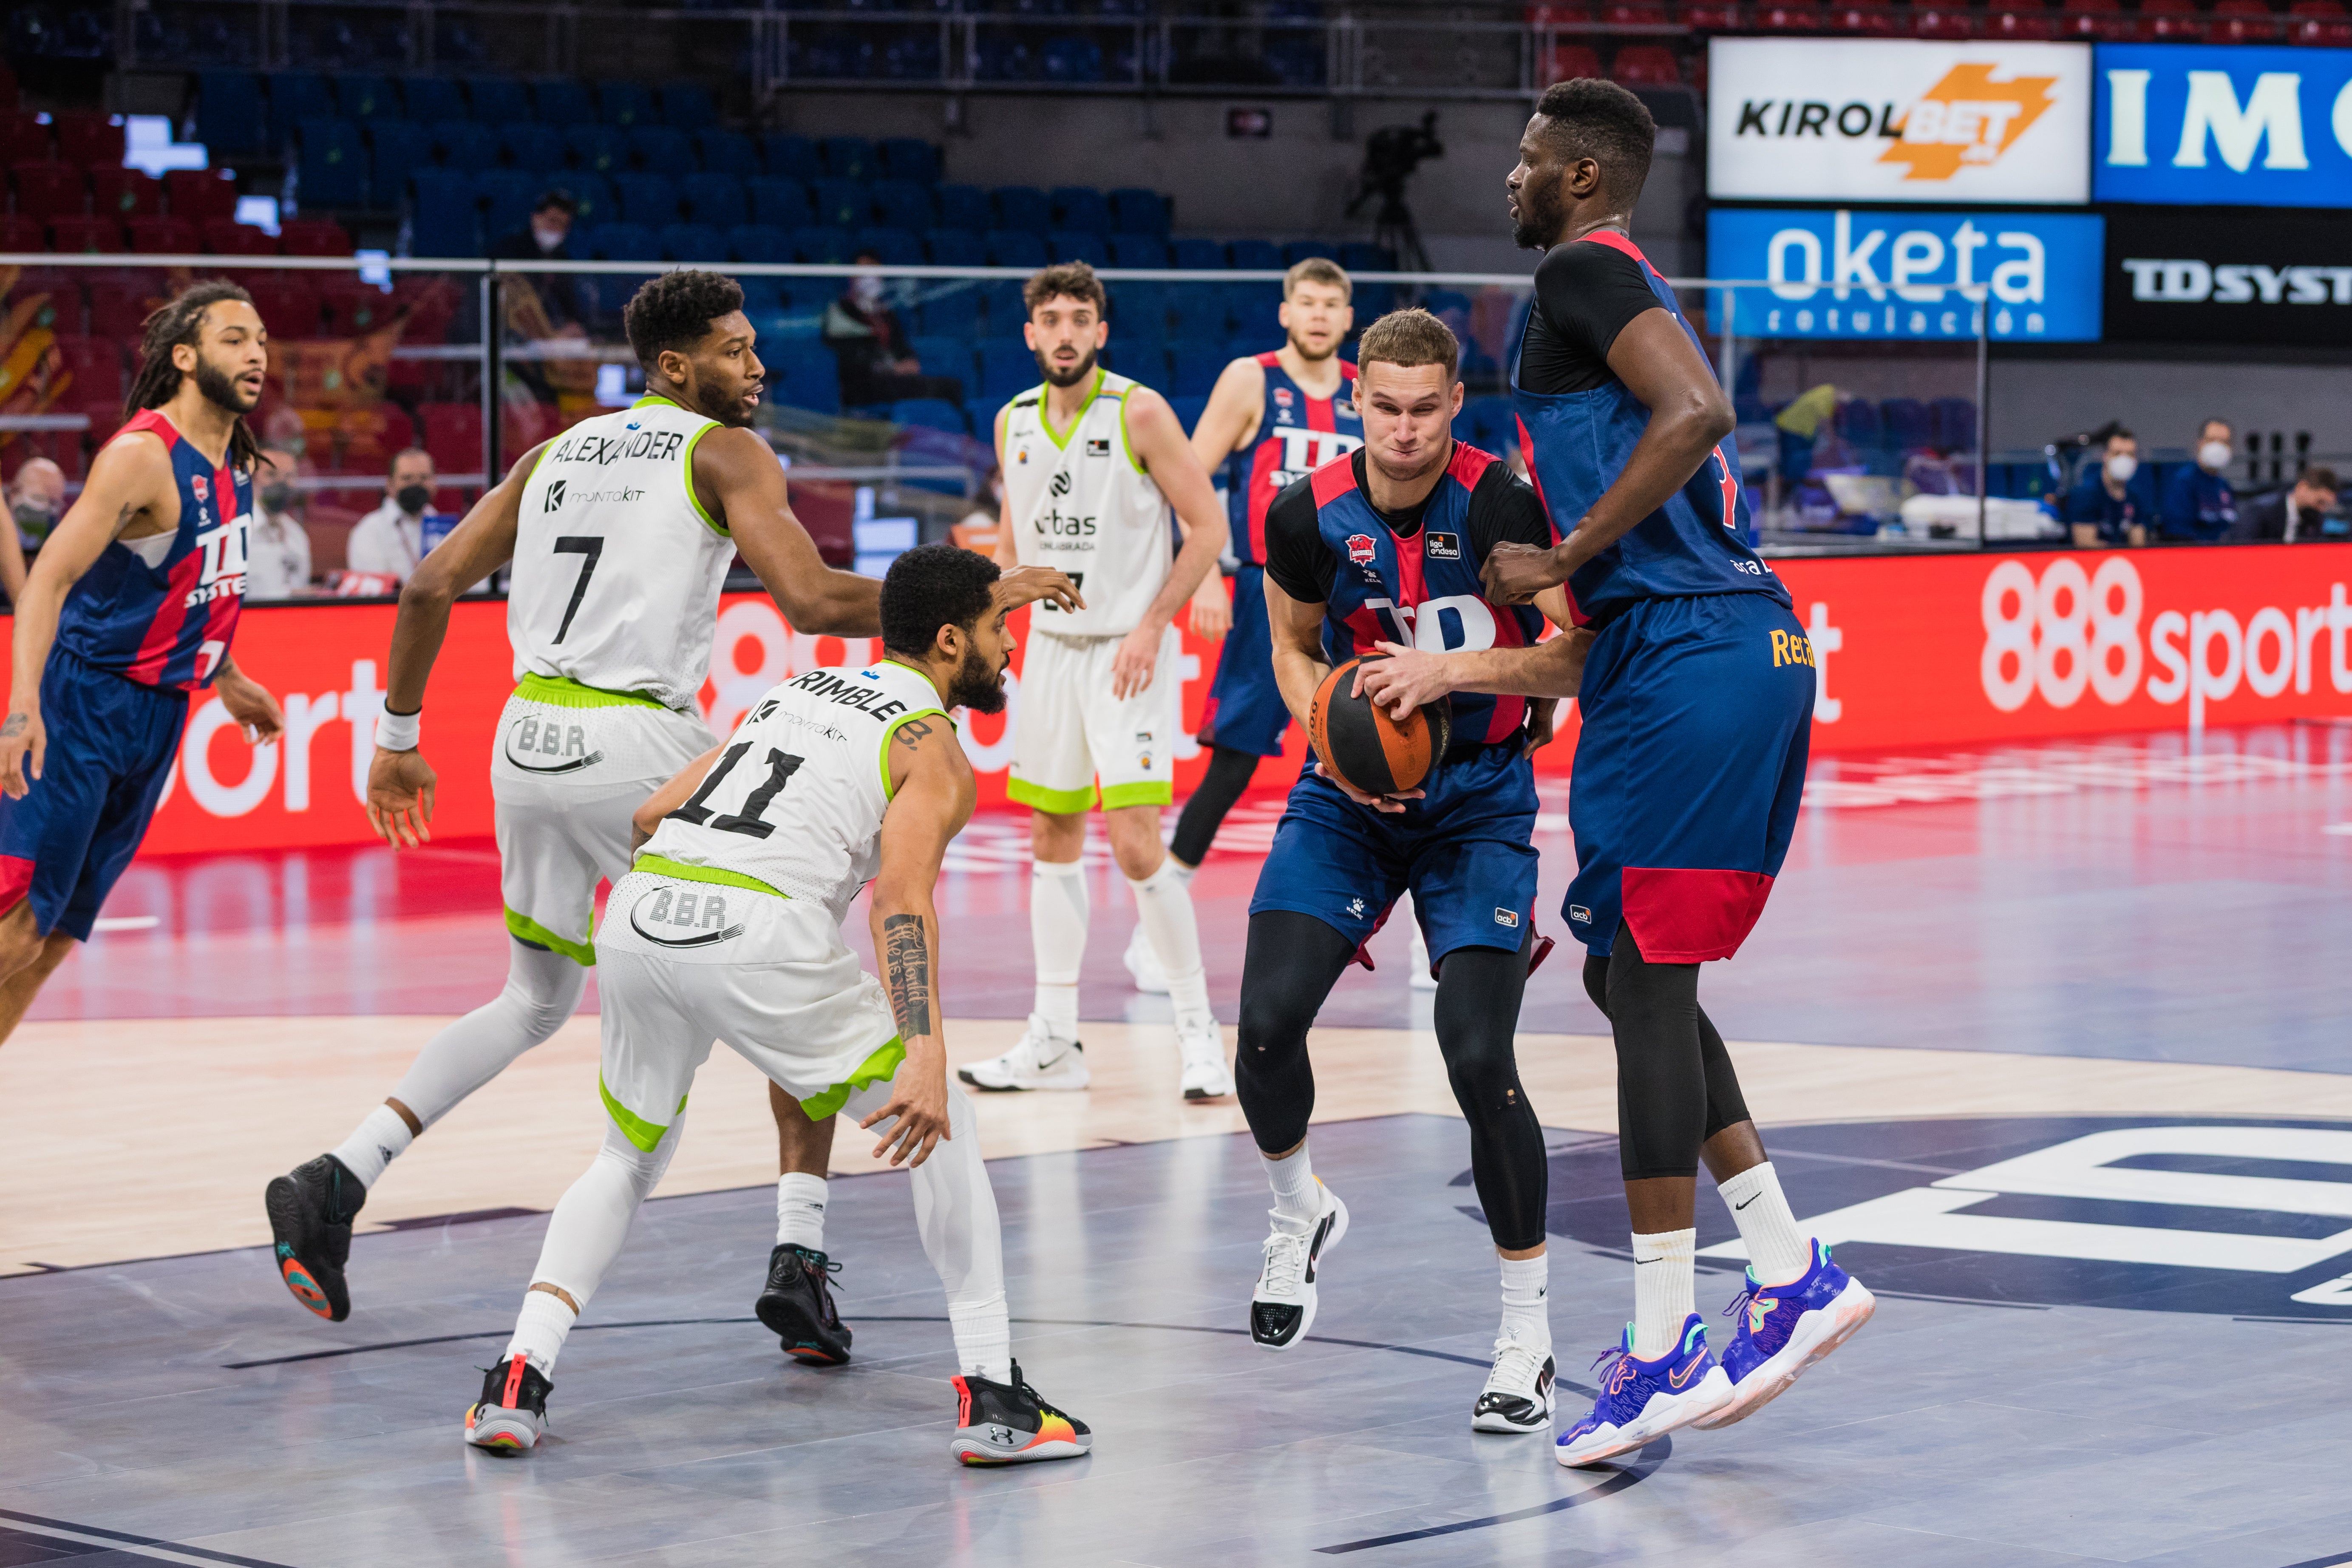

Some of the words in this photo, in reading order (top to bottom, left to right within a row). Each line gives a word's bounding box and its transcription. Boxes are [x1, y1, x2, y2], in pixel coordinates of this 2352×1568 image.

[2105, 69, 2352, 173] IM
[1767, 211, 2045, 303] oketa
[550, 431, 683, 465] ALEXANDER
[550, 536, 604, 644] 7
[777, 671, 908, 722] RIMBLE
[665, 741, 805, 839] 11
[1497, 915, 1512, 924] acb
[1573, 910, 1587, 920] acb
